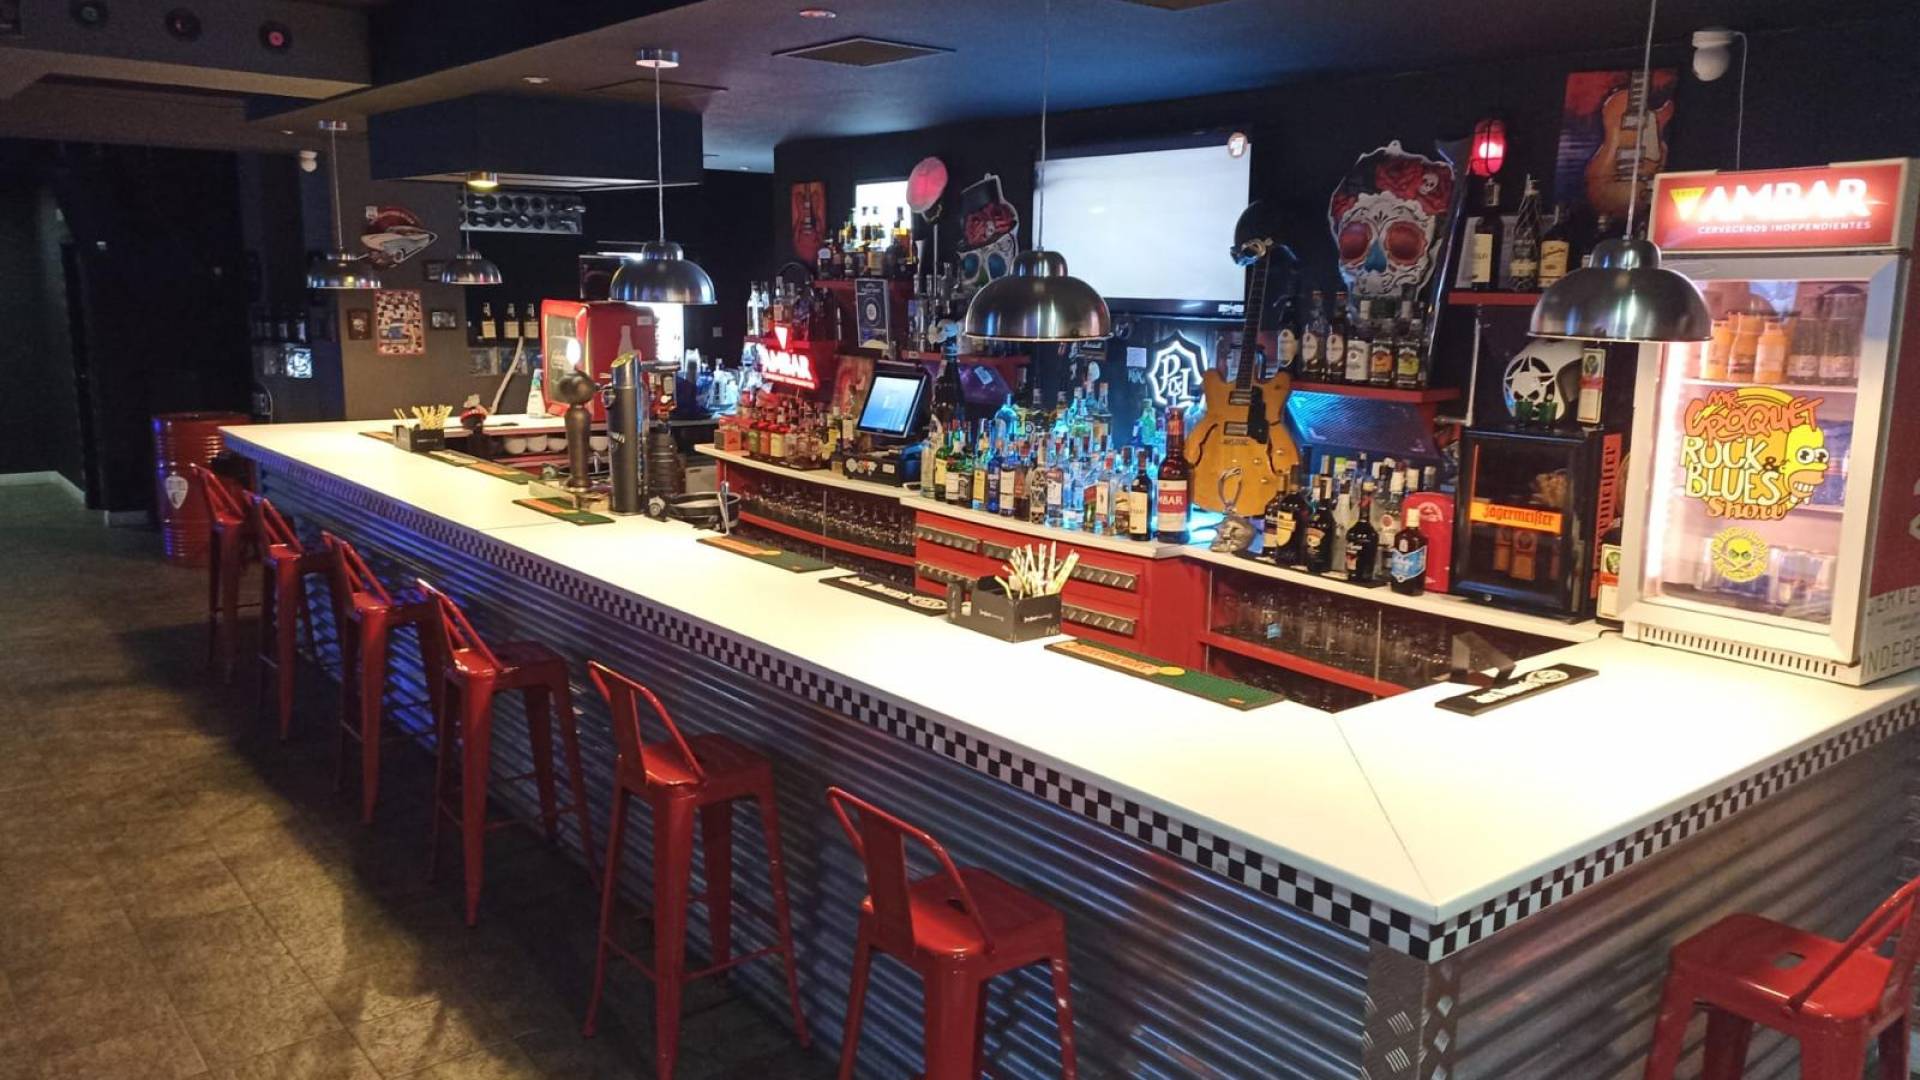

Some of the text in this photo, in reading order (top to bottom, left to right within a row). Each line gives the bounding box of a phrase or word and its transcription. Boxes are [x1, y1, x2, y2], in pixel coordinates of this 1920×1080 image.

[1700, 178, 1872, 221] AMBAR
[1697, 221, 1872, 235] CERVECEROS INDEPENDIENTES
[1685, 396, 1825, 447] CROQUET
[1680, 434, 1781, 472] ROCK &
[1685, 463, 1782, 506] BLUES
